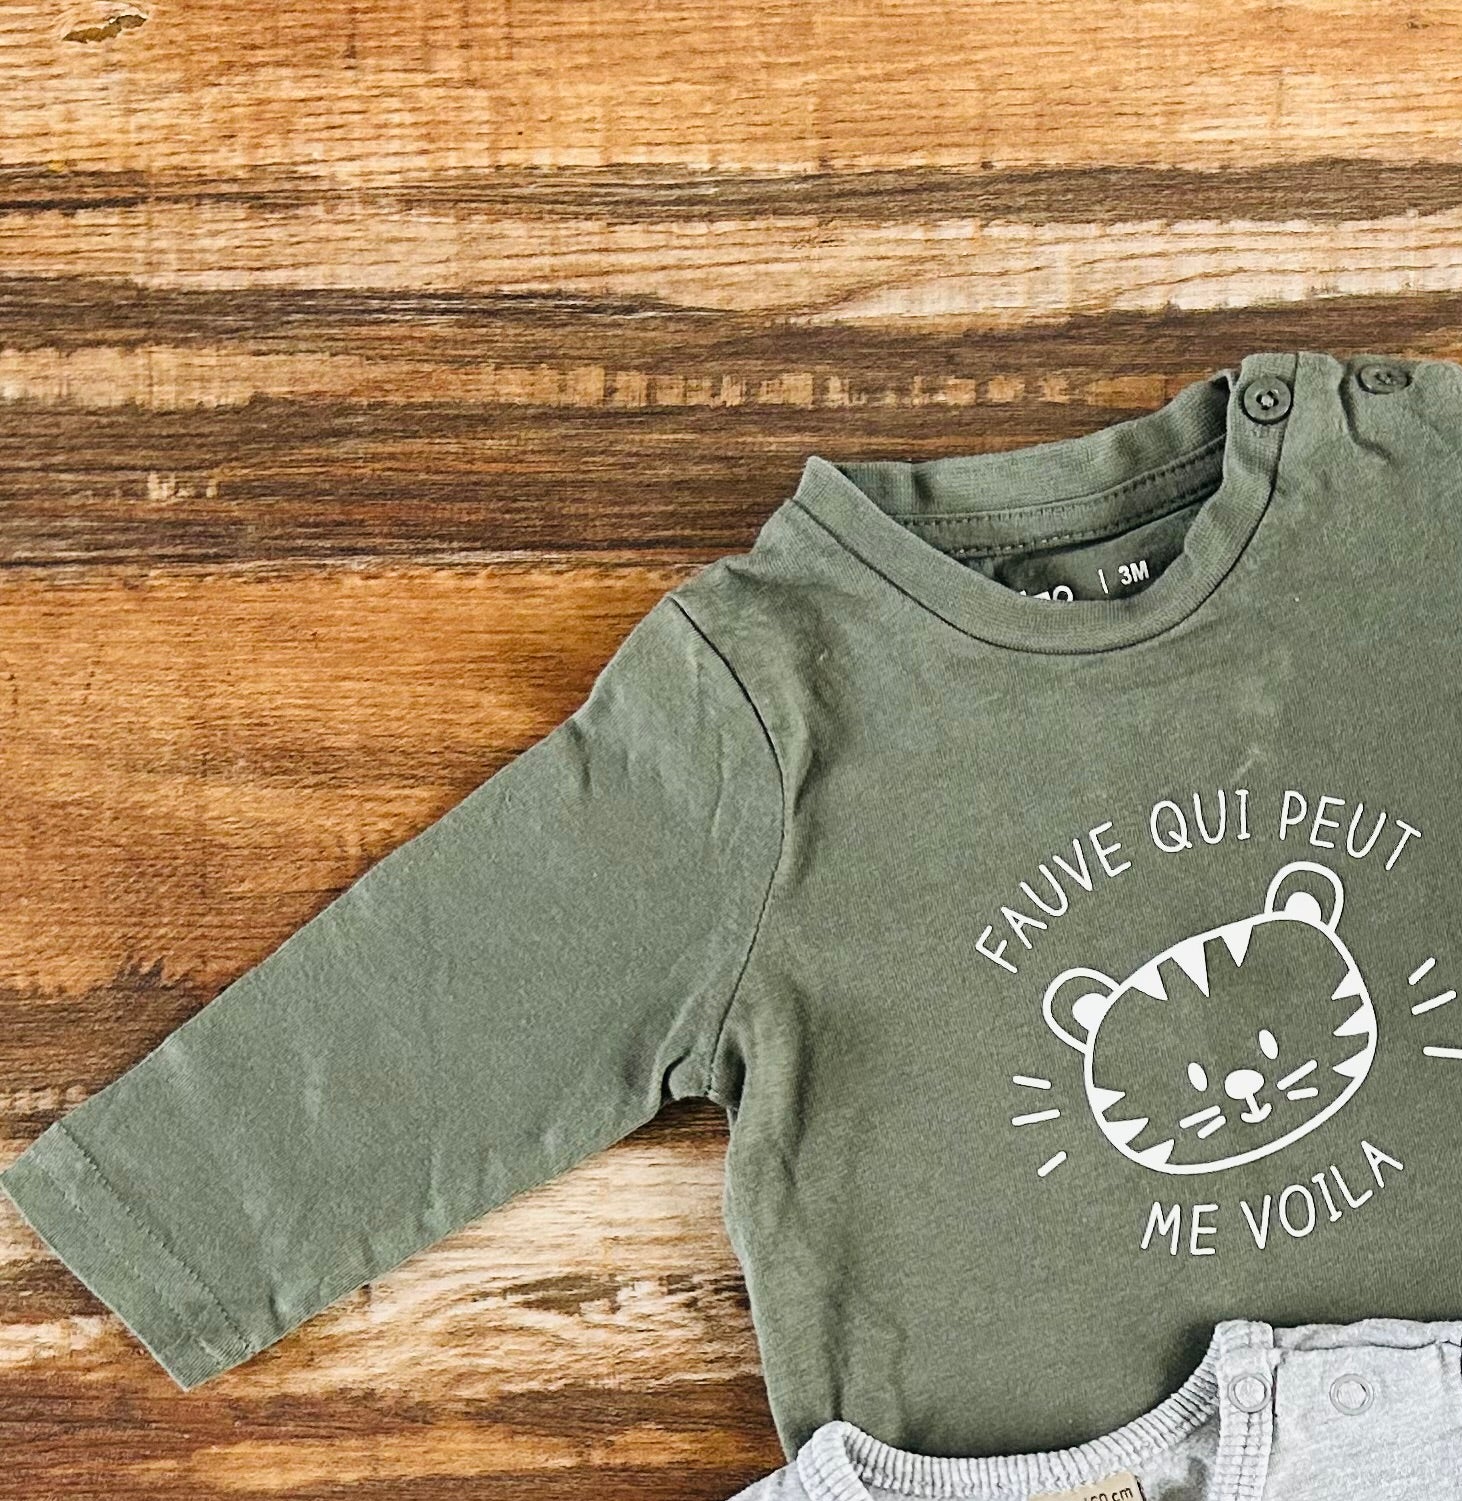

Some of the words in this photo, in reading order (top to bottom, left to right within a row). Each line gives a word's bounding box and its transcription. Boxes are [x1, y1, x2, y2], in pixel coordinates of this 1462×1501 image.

[1118, 560, 1150, 585] 3M
[975, 821, 1132, 974] FAUVE
[1149, 788, 1251, 853] QUI
[1279, 789, 1422, 871] PEUT
[1141, 1201, 1219, 1256] ME
[1240, 1140, 1404, 1250] VOILA
